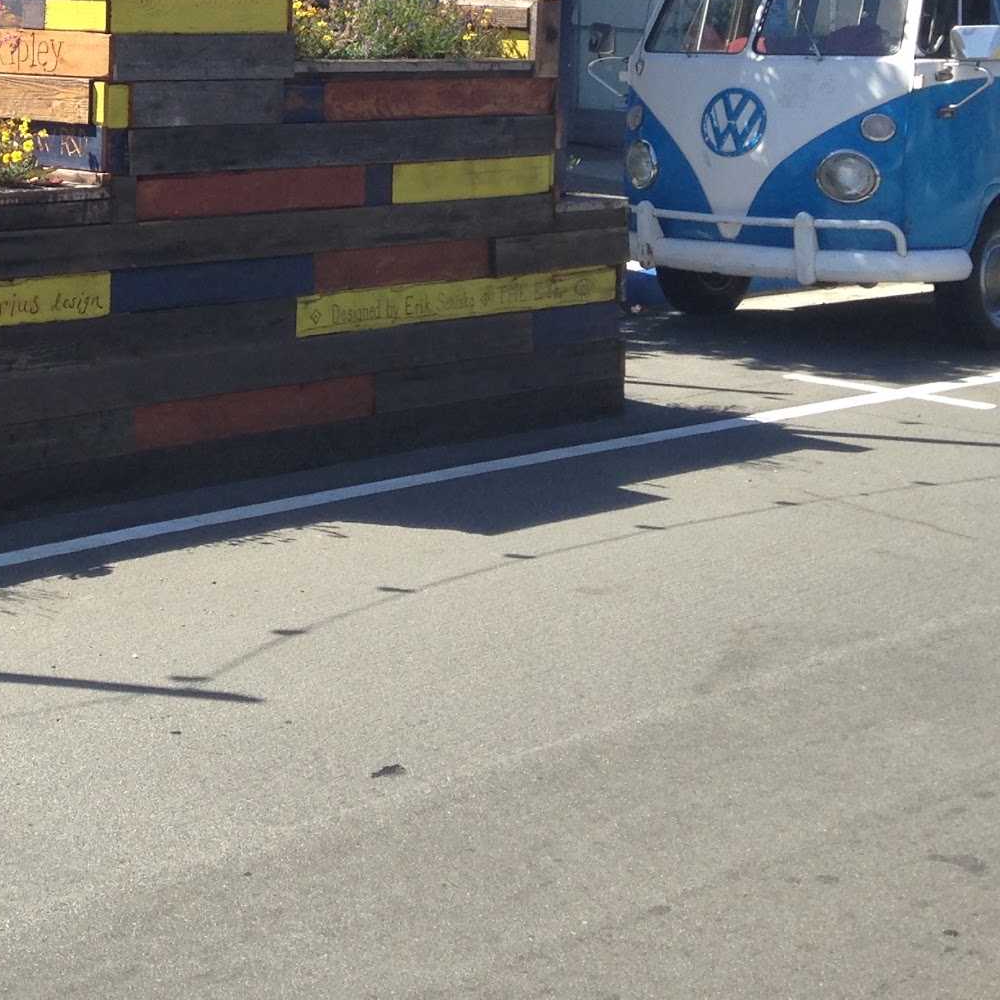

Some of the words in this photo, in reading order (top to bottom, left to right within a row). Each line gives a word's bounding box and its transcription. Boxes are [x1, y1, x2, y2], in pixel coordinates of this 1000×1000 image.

[50, 292, 103, 314] design
[331, 302, 381, 326] Designed
[385, 302, 399, 325] by
[405, 295, 431, 316] Erik
